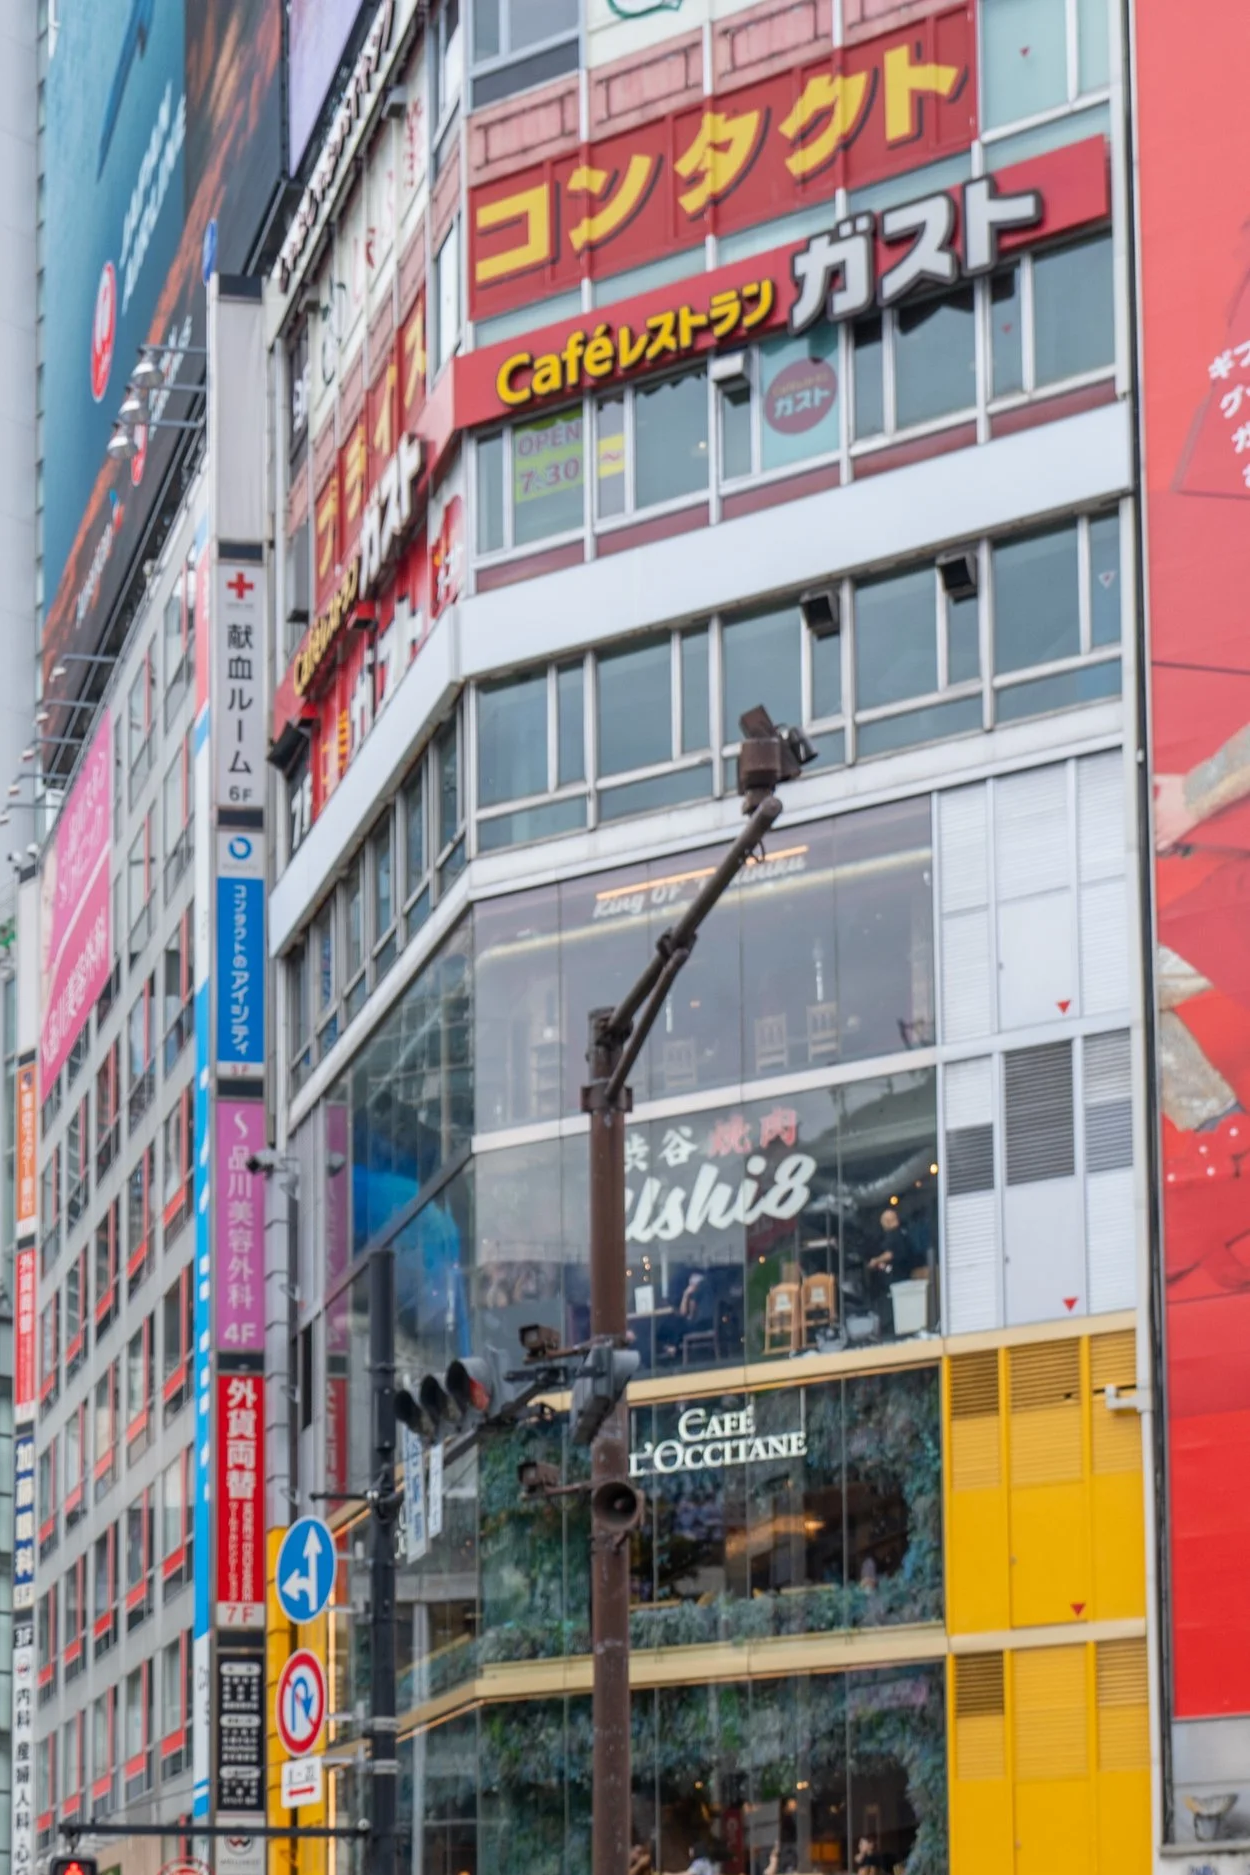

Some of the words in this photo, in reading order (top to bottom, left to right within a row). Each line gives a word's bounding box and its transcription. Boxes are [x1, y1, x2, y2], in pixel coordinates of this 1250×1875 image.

[476, 45, 958, 282] コンタクト
[792, 180, 1040, 333] ガスト
[518, 420, 582, 457] OPEN
[227, 624, 254, 774] 献血ルーム
[229, 785, 253, 801] 6F
[227, 1145, 255, 1310] 品川美容外科
[224, 1322, 257, 1343] 4F
[226, 1377, 257, 1499] 外貨両替
[628, 1430, 808, 1478] L'OCCITANE
[226, 1606, 254, 1624] 7F
